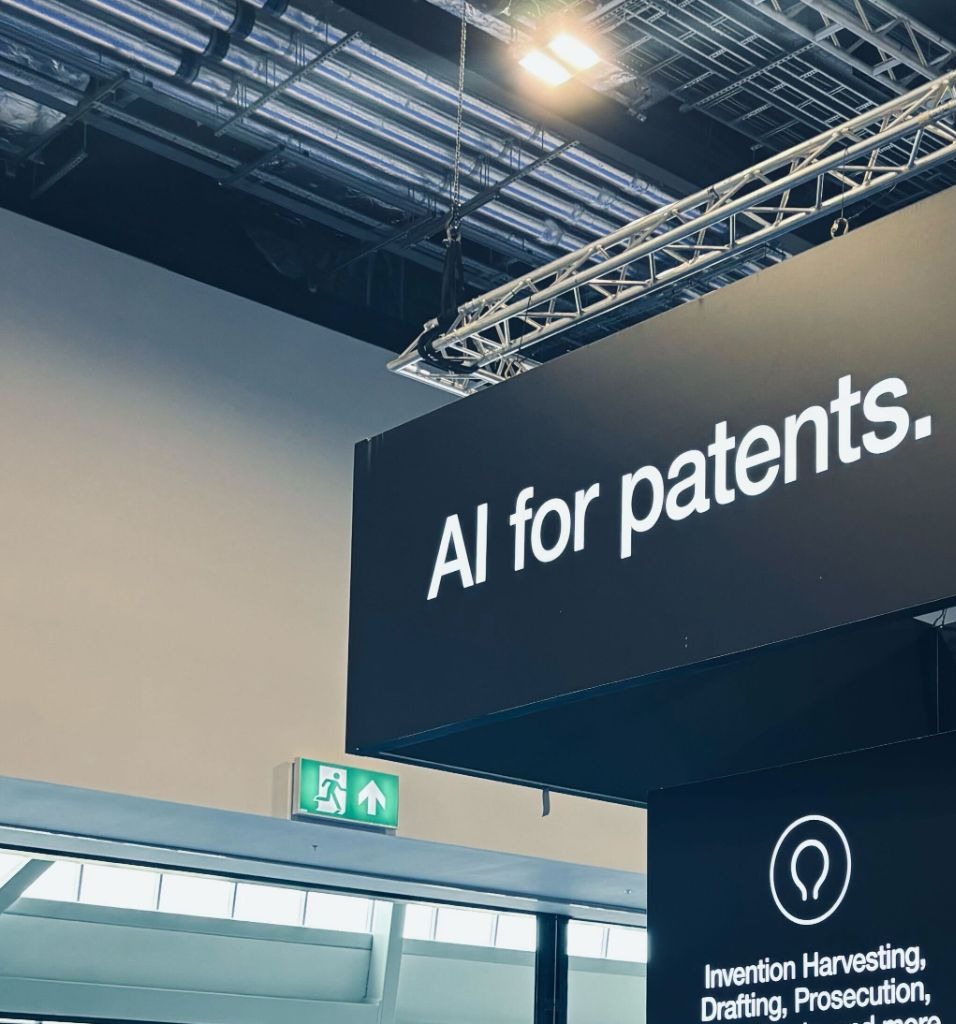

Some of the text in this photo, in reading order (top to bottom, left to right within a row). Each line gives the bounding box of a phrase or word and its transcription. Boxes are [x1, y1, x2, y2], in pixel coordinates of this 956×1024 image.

[427, 374, 932, 600] AI for patents.
[705, 943, 926, 989] Invention Harvesting,
[701, 978, 931, 1022] Drafting, Prosecution,
